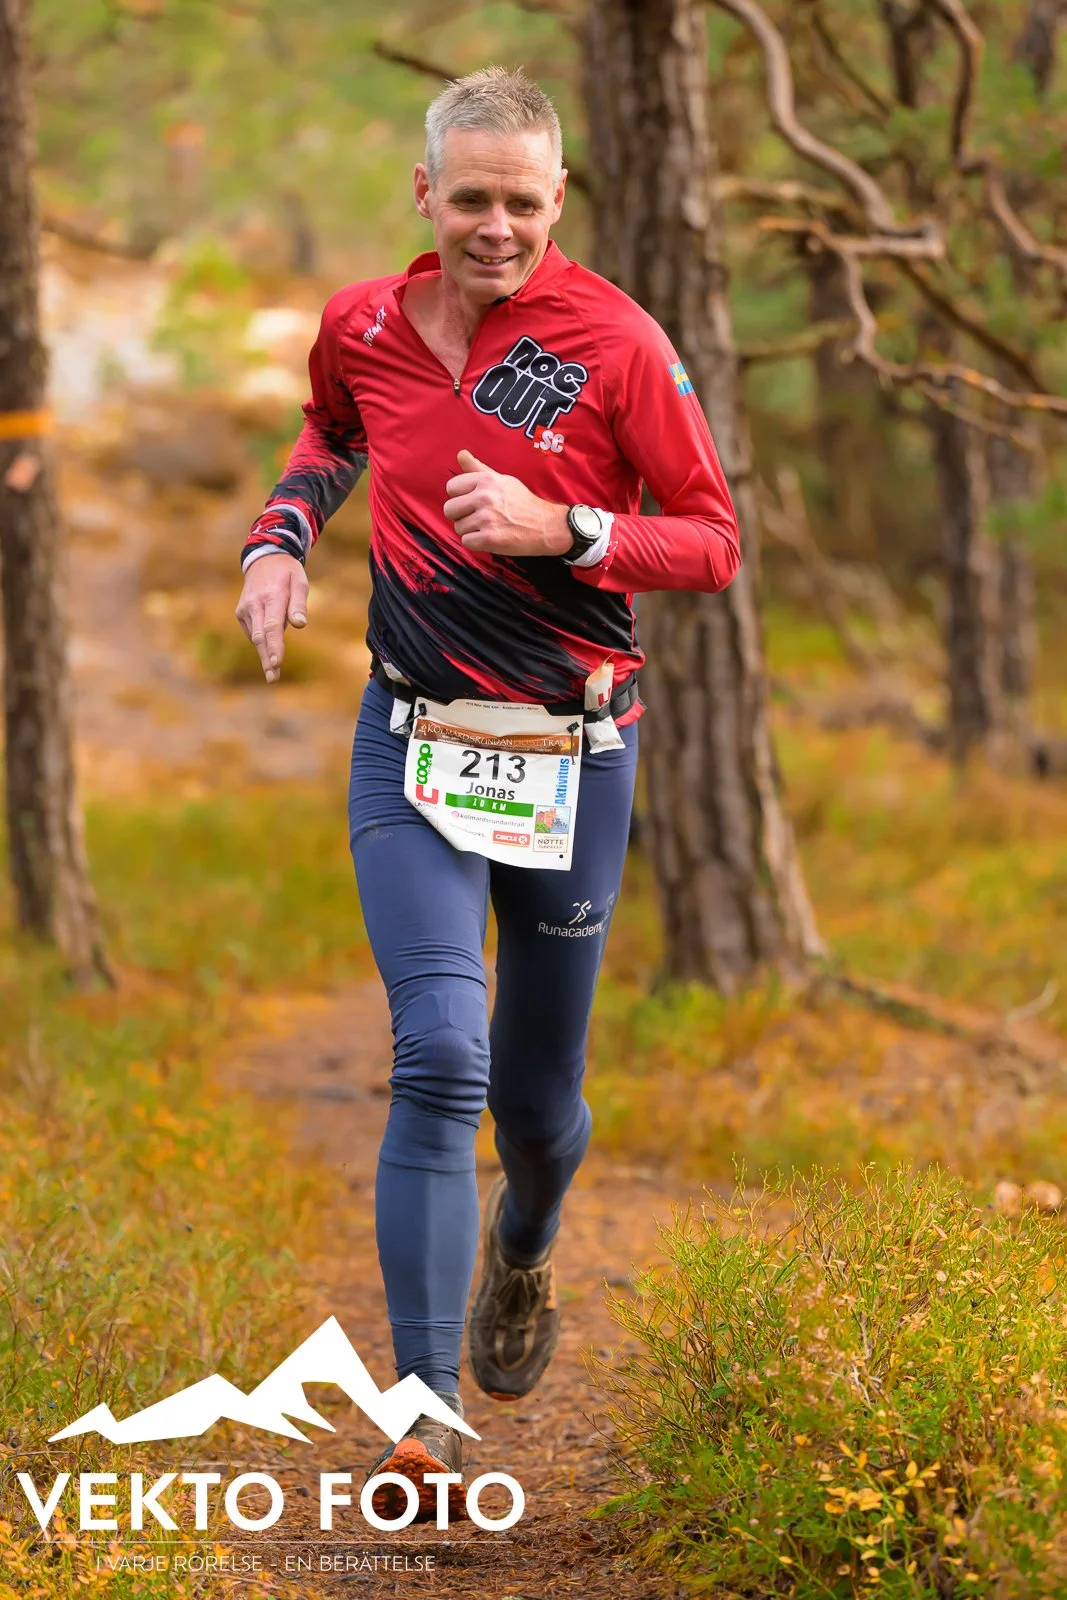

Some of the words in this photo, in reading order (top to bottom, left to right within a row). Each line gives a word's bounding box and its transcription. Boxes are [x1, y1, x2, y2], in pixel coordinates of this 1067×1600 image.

[472, 362, 579, 440] OUT
[542, 738, 566, 748] TRA
[416, 743, 433, 785] coop
[459, 750, 526, 783] 213
[465, 782, 515, 801] Jonas
[554, 758, 570, 805] Aktivitus
[472, 798, 486, 808] 10
[491, 801, 507, 811] KM
